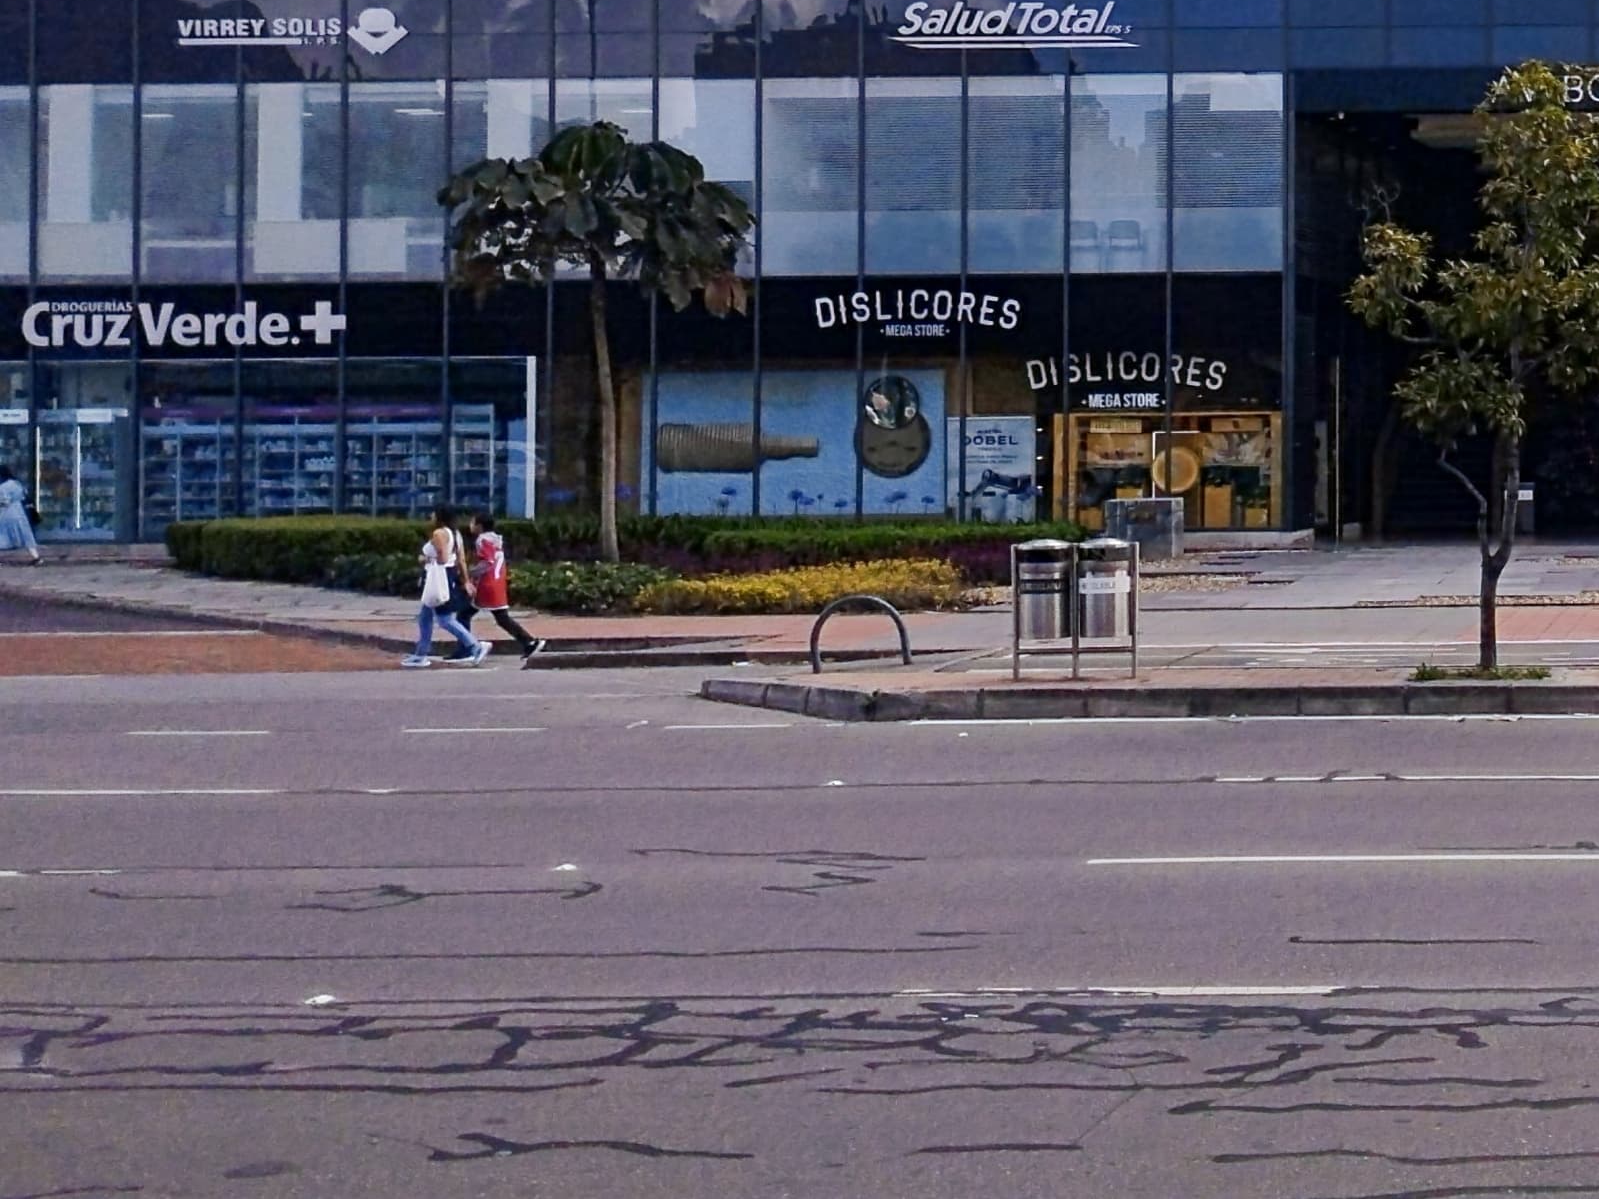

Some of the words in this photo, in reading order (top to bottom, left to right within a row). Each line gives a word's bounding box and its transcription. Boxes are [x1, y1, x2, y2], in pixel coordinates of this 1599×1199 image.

[178, 17, 265, 37] VIRREY
[272, 17, 341, 37] SOLIS
[22, 301, 131, 346] Cruz
[815, 289, 1021, 329] DISLICORES
[886, 325, 912, 336] MEGA
[915, 325, 945, 336] STORE
[1026, 351, 1227, 390] DISLICORES
[1088, 394, 1121, 408] MEGA
[1124, 394, 1160, 408] STORE
